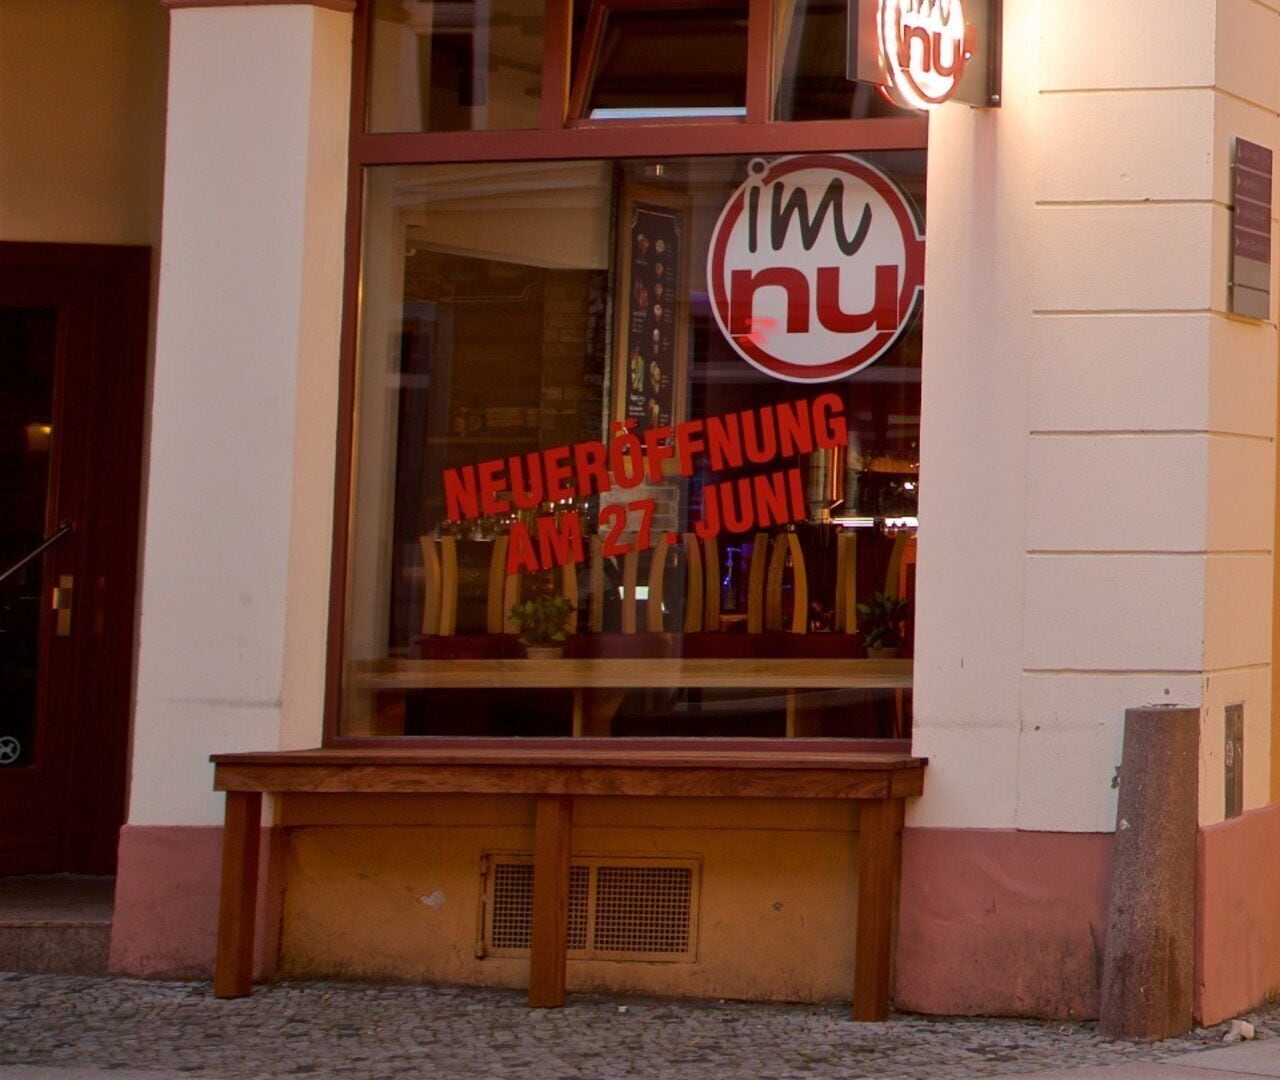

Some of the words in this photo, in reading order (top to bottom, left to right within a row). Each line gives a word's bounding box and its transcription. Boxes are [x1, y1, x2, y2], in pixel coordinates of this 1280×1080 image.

[899, 24, 962, 78] nu
[746, 157, 872, 257] im
[729, 264, 899, 335] nu
[442, 392, 849, 523] NEUERÖFFNUNG
[506, 516, 584, 576] AM
[598, 498, 679, 558] 27.
[695, 468, 806, 541] JUNI
